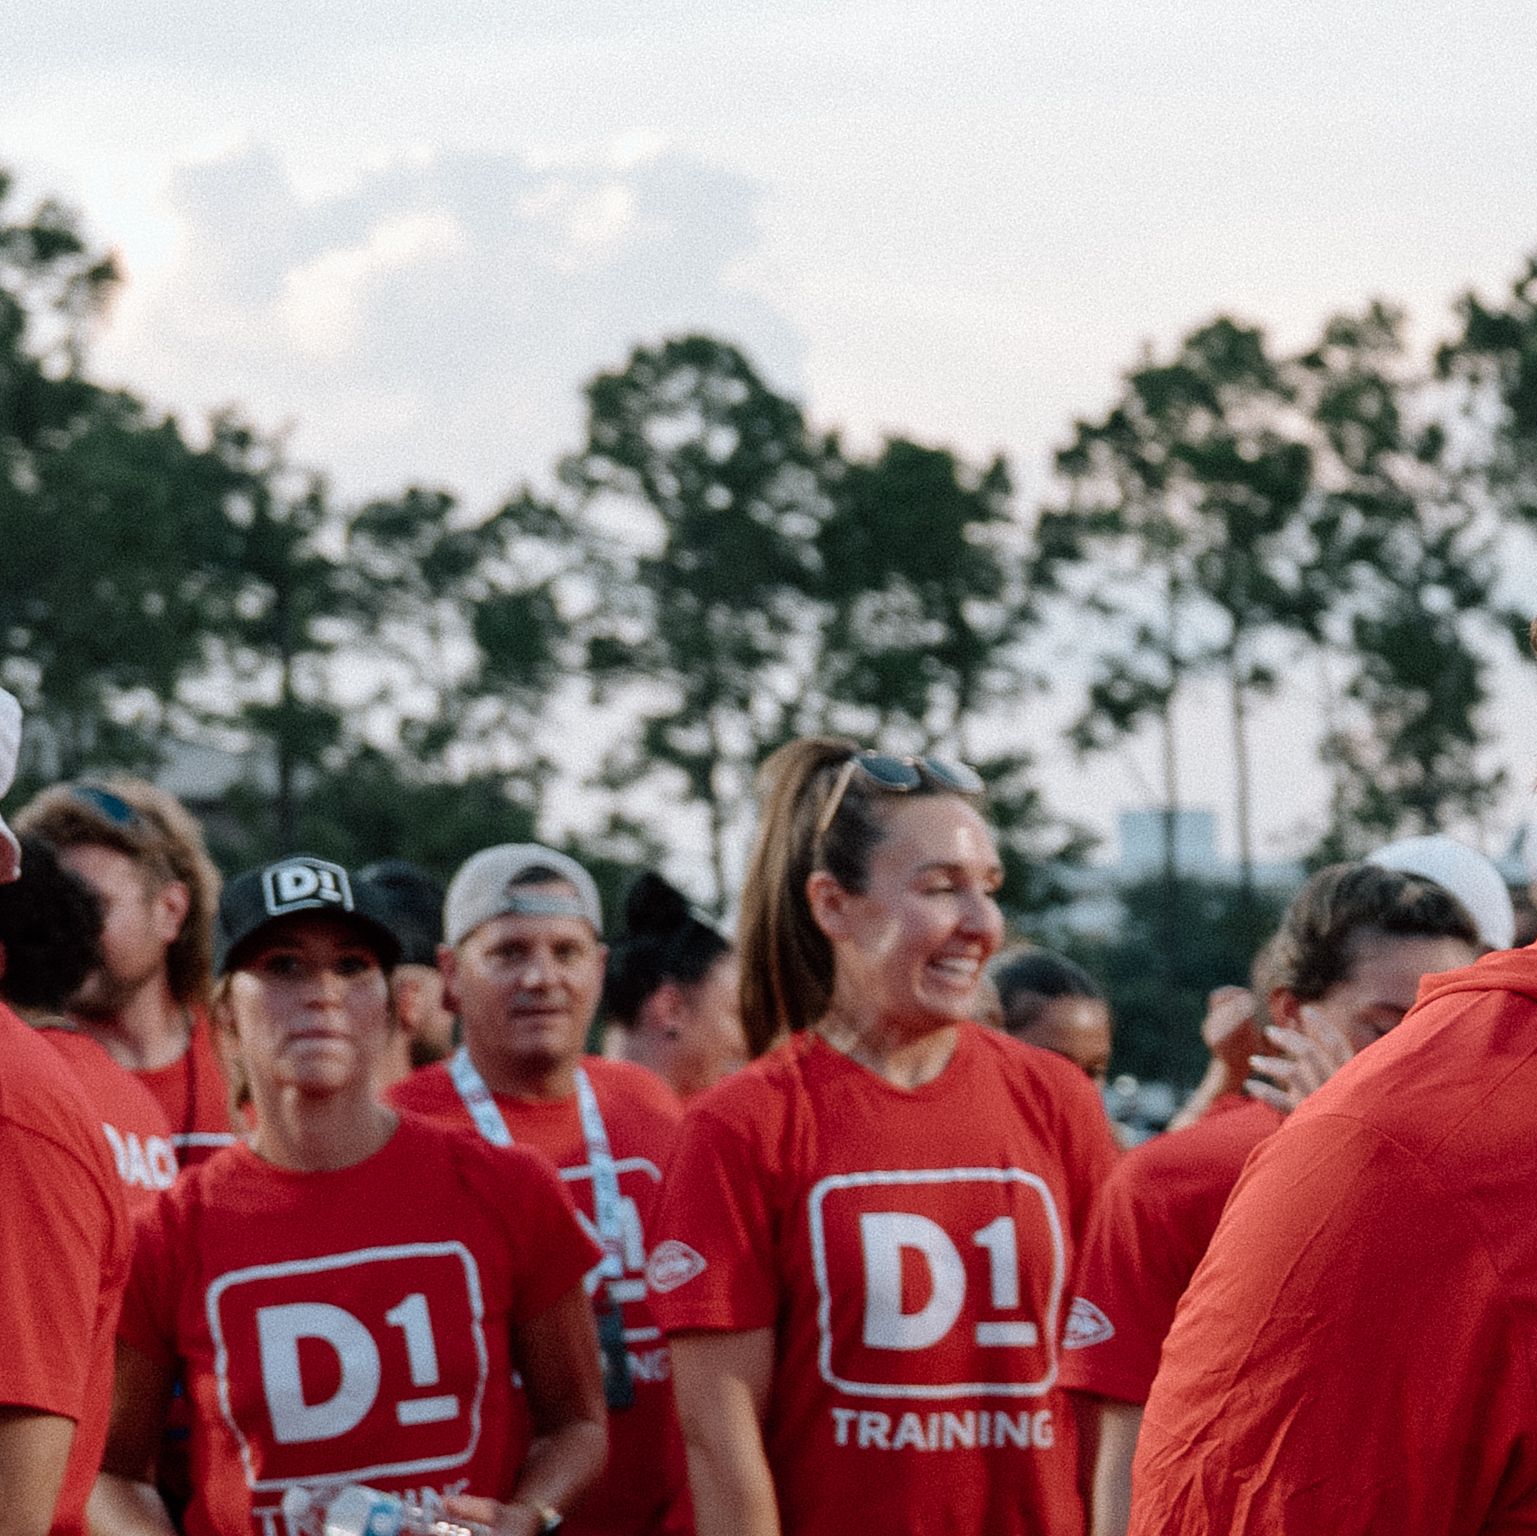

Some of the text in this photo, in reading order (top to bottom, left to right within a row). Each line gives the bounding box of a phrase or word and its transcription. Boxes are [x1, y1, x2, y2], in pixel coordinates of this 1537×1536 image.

[279, 866, 342, 903] D1
[860, 1212, 1038, 1351] D1
[256, 1292, 460, 1446] D1
[830, 1407, 1054, 1452] TRAINING
